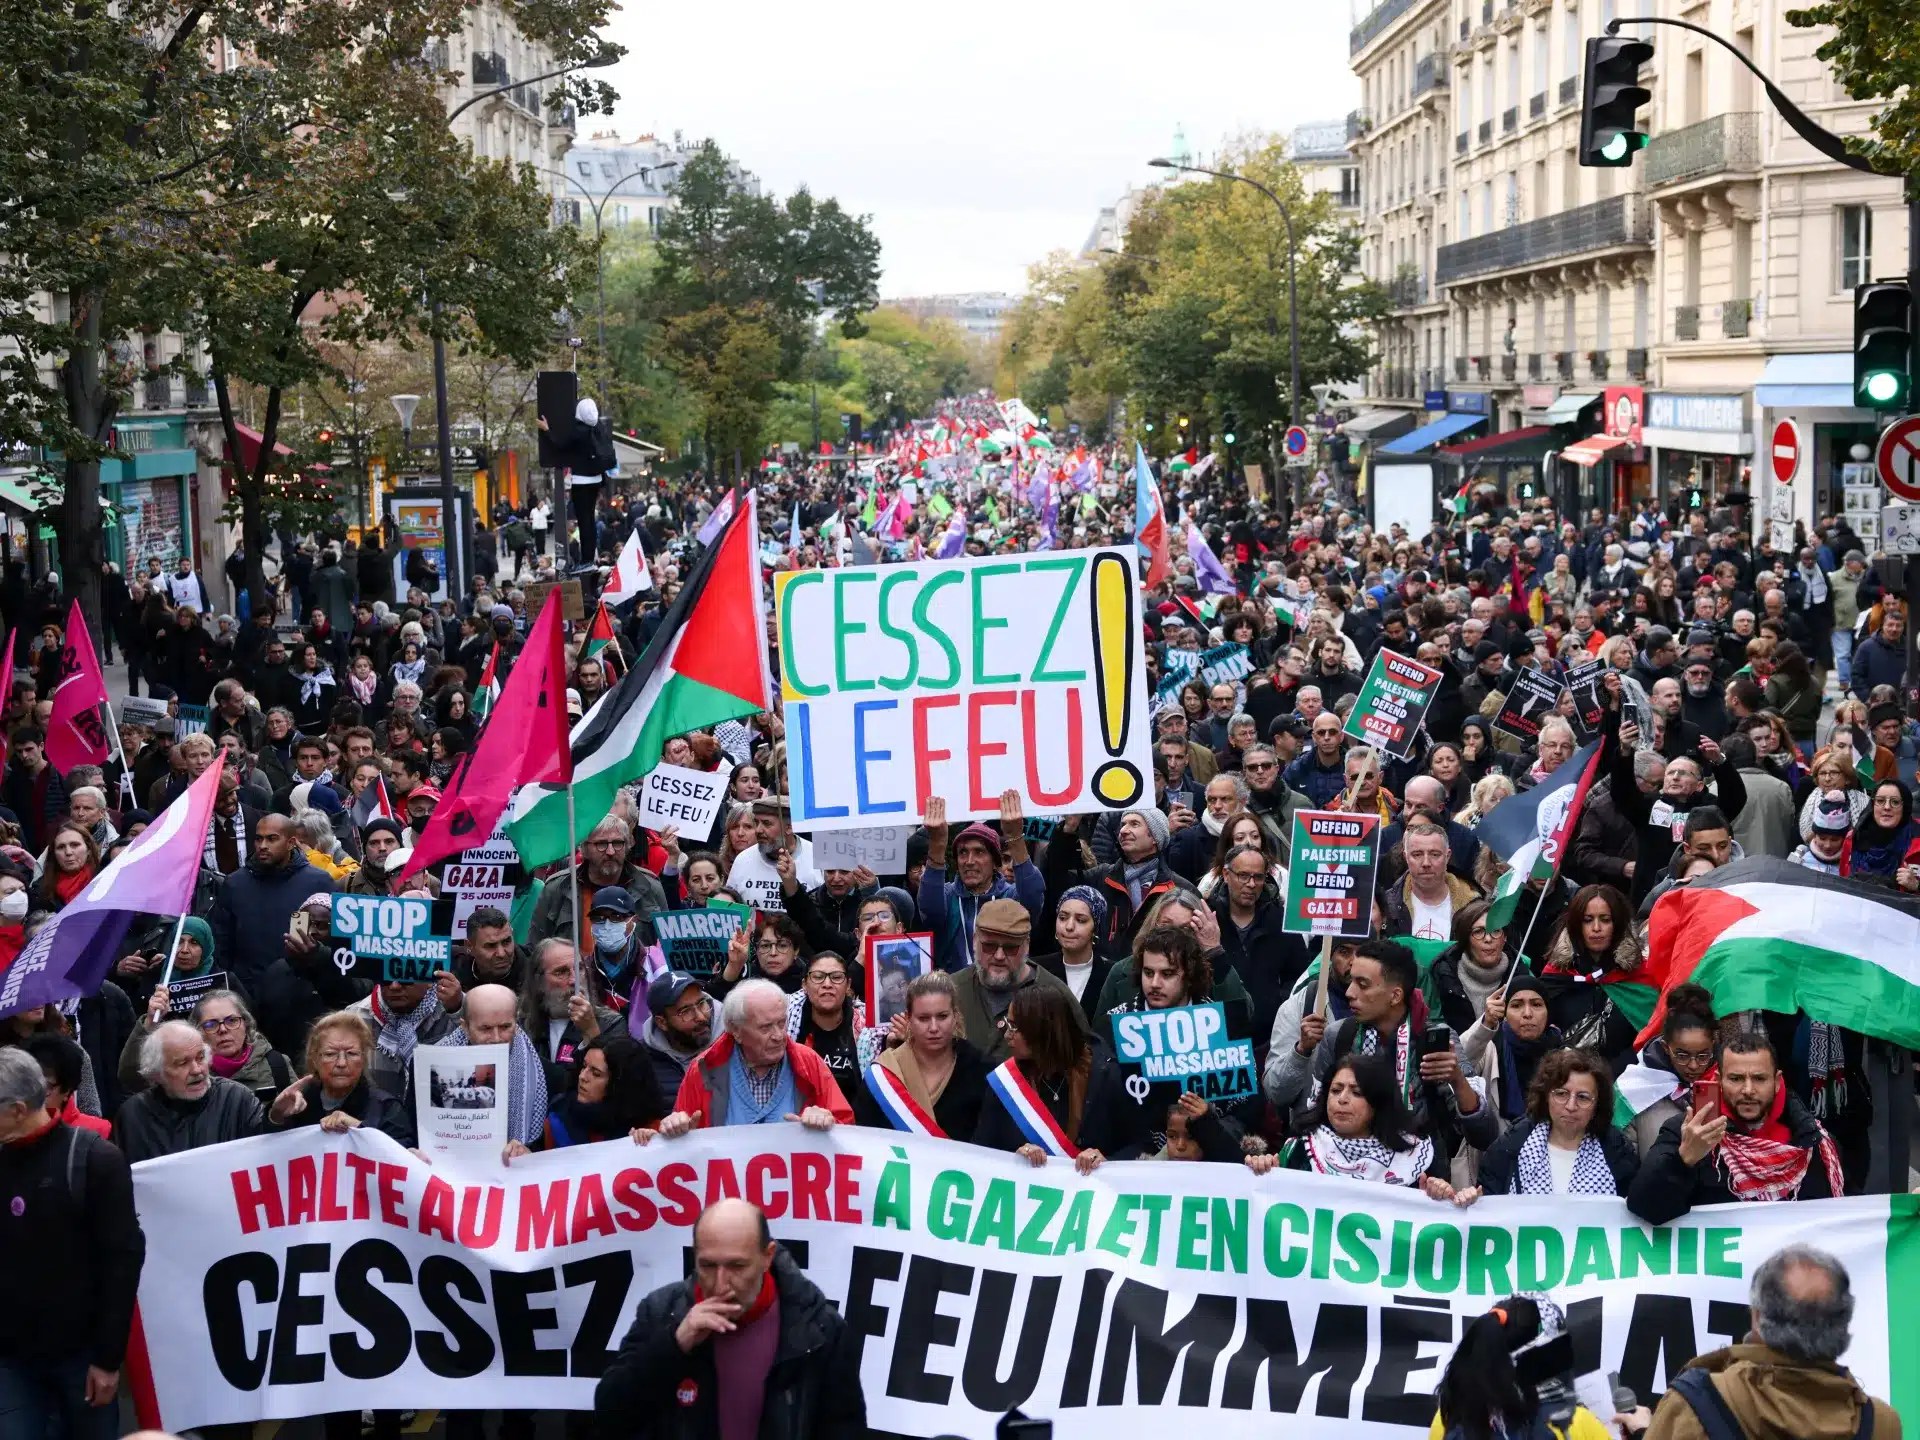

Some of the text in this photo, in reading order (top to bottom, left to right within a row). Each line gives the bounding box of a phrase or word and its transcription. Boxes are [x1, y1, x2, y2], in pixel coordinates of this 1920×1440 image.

[781, 556, 1089, 696] CESSEZ
[1166, 649, 1198, 669] STO
[1201, 649, 1257, 688] PAIX
[1388, 659, 1426, 682] DEFEND
[1090, 551, 1144, 808] !
[1373, 677, 1424, 704] PALESTINE
[1371, 696, 1408, 719] DEFEND
[1365, 717, 1401, 738] GAZA !
[797, 687, 1085, 819] LE FEU
[651, 774, 716, 801] CESSEZ-
[647, 796, 711, 824] LE-FEU !
[1311, 820, 1360, 836] DEFEND
[1301, 848, 1367, 862] PALESTINE
[447, 865, 499, 888] GAZA
[1306, 873, 1355, 889] DEFEND
[461, 892, 512, 900] 35 JOURS
[747, 900, 760, 909] LA
[1307, 901, 1353, 915] GAZA !
[335, 896, 427, 938] STOP
[655, 912, 742, 940] MARCHE
[355, 935, 449, 959] MASSACRE
[388, 957, 445, 981] GAZA
[1118, 1007, 1221, 1058] STOP
[1144, 1044, 1251, 1078] MASSACRE
[1187, 1067, 1253, 1099] GAZA
[229, 1145, 1743, 1297] HALTE AU MASSACRE À GAZA ET EN CISJORDANIE
[203, 1238, 635, 1392] CESSEZ
[843, 1246, 1061, 1413] FEU
